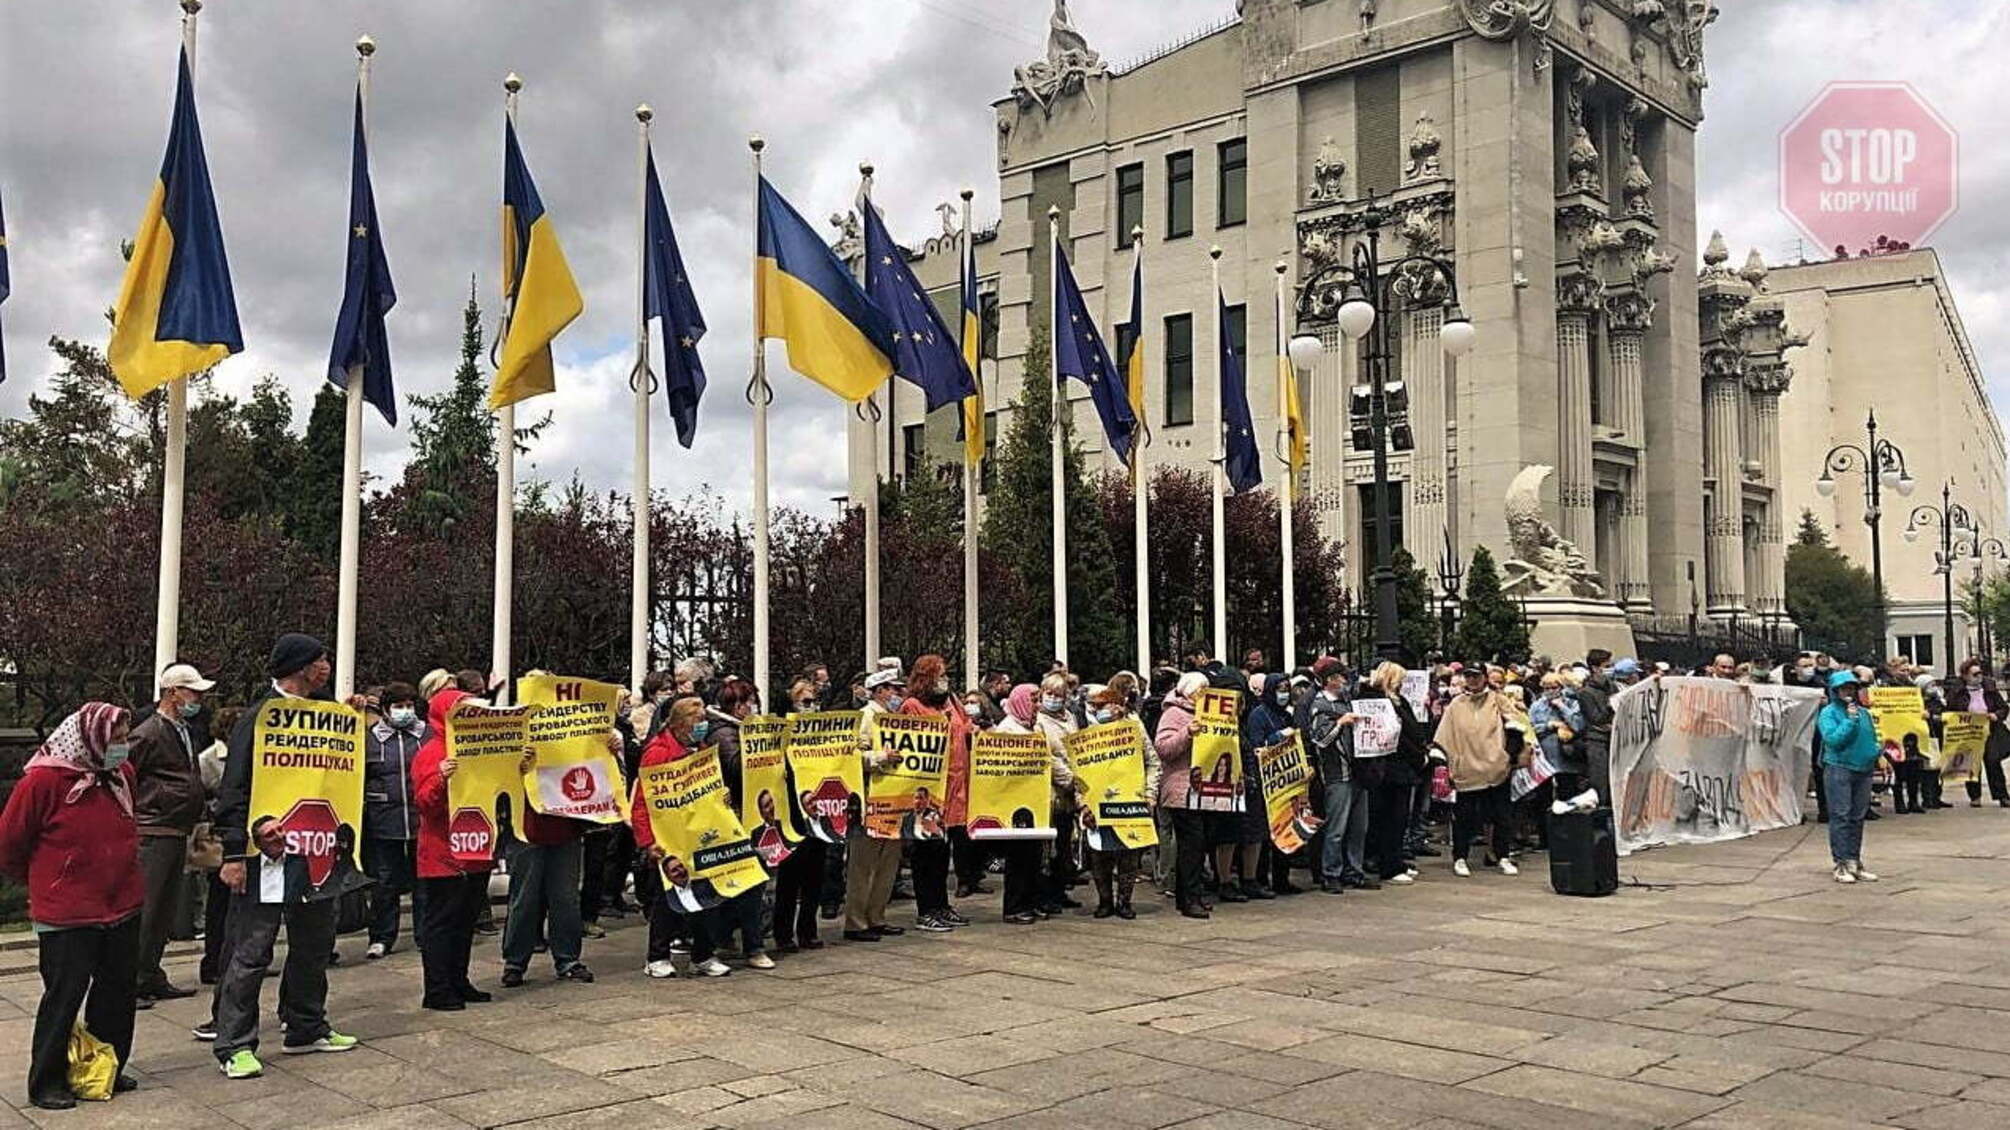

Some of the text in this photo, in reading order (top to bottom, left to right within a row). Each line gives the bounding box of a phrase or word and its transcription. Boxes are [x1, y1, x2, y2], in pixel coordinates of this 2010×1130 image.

[556, 682, 582, 701] НІ
[267, 708, 356, 735] ЗУПИНИ
[529, 716, 610, 732] БРОВАРСЬКОГО
[792, 717, 856, 734] ЗУПИНИ
[880, 717, 949, 733] ПОВЕРНИ
[880, 731, 948, 754] НАШІ
[977, 738, 1047, 749] АКЦІОНЕРИ
[263, 752, 355, 771] ПОЛІЩУКА!
[652, 784, 669, 795] ЗА
[816, 799, 849, 817] STOP
[285, 831, 336, 857] STOP
[450, 831, 489, 852] STOP
